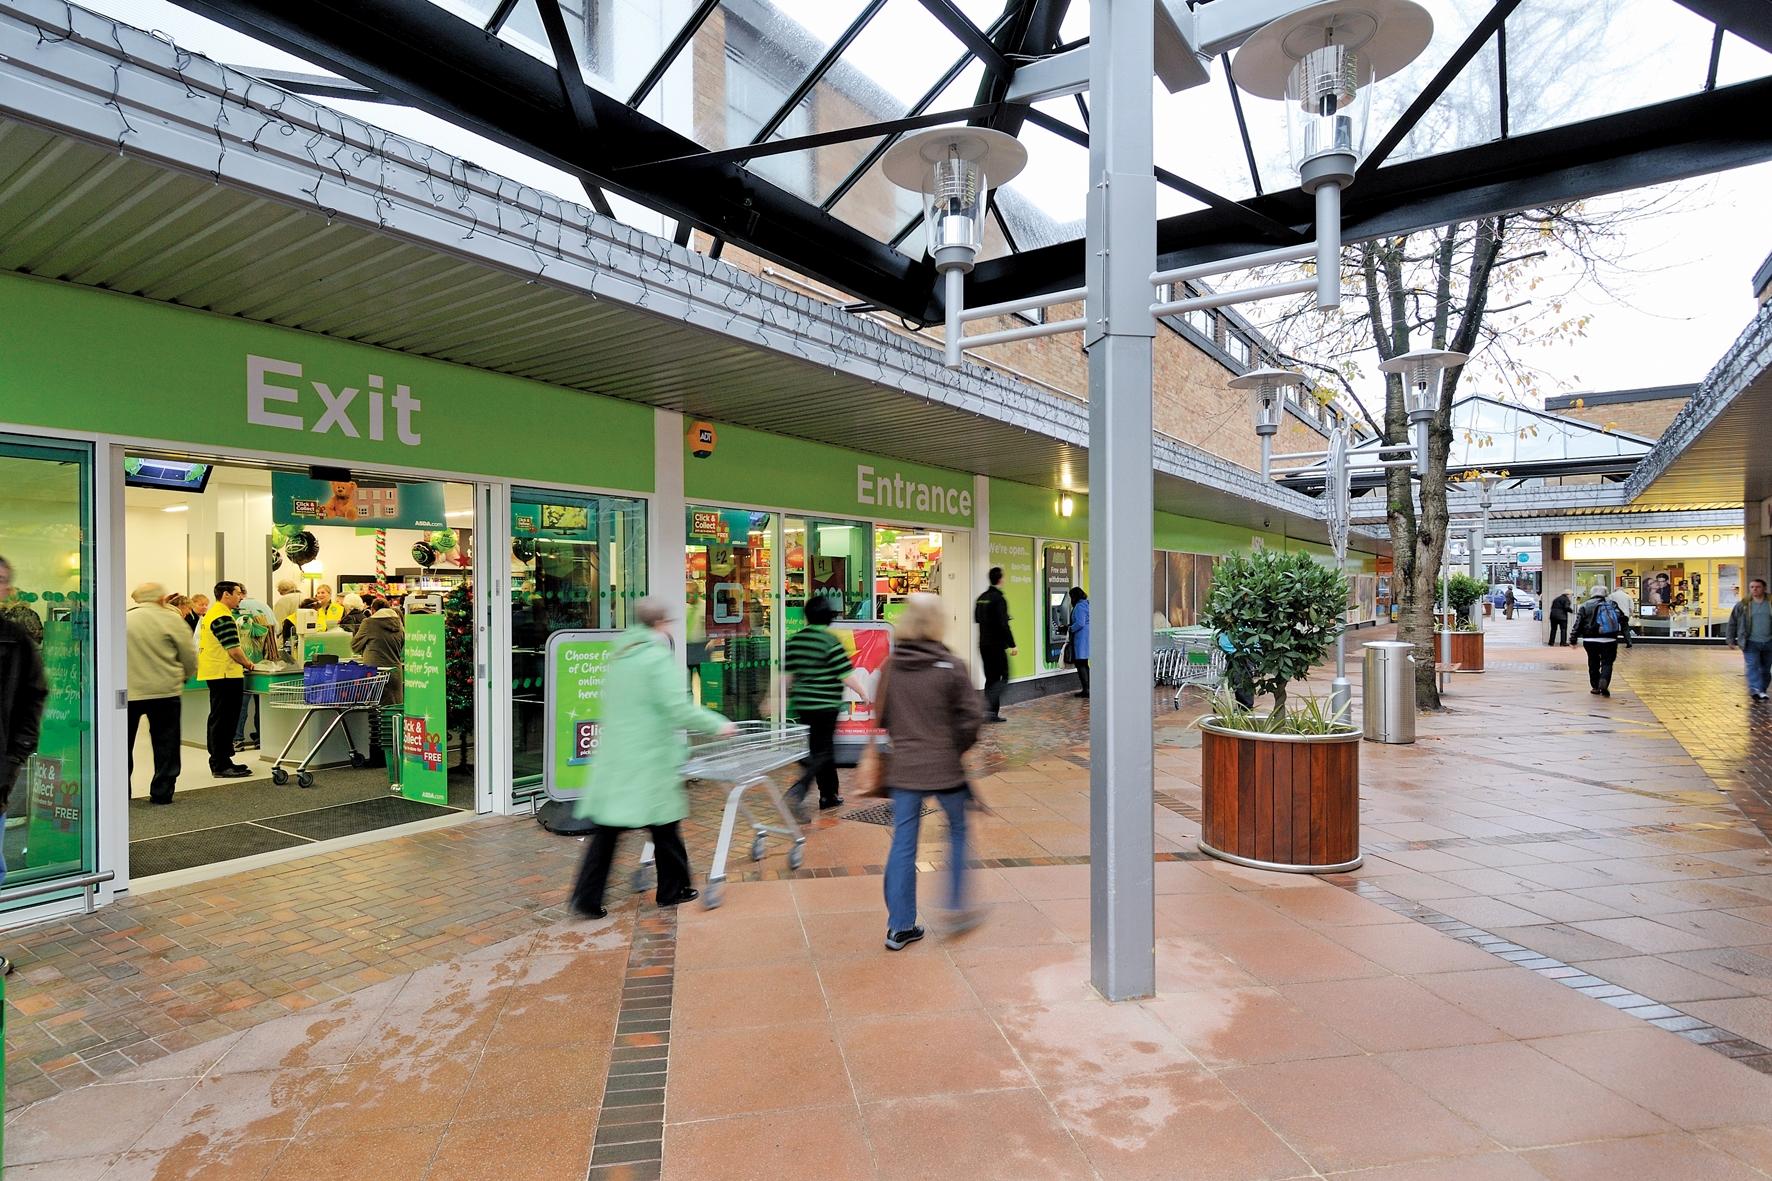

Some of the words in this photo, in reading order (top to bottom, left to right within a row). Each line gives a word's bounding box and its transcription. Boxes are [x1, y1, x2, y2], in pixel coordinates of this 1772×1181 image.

[247, 354, 421, 446] Exit
[700, 432, 711, 441] ADT
[857, 464, 971, 517] Entrance
[695, 513, 710, 521] Click
[695, 521, 716, 529] Collect
[1574, 534, 1689, 549] BARRADELLS
[565, 649, 599, 661] Choose
[568, 663, 580, 674] of
[578, 689, 598, 700] here
[580, 724, 605, 737] Clic
[424, 751, 442, 762] FREE
[55, 806, 78, 820] FREE
